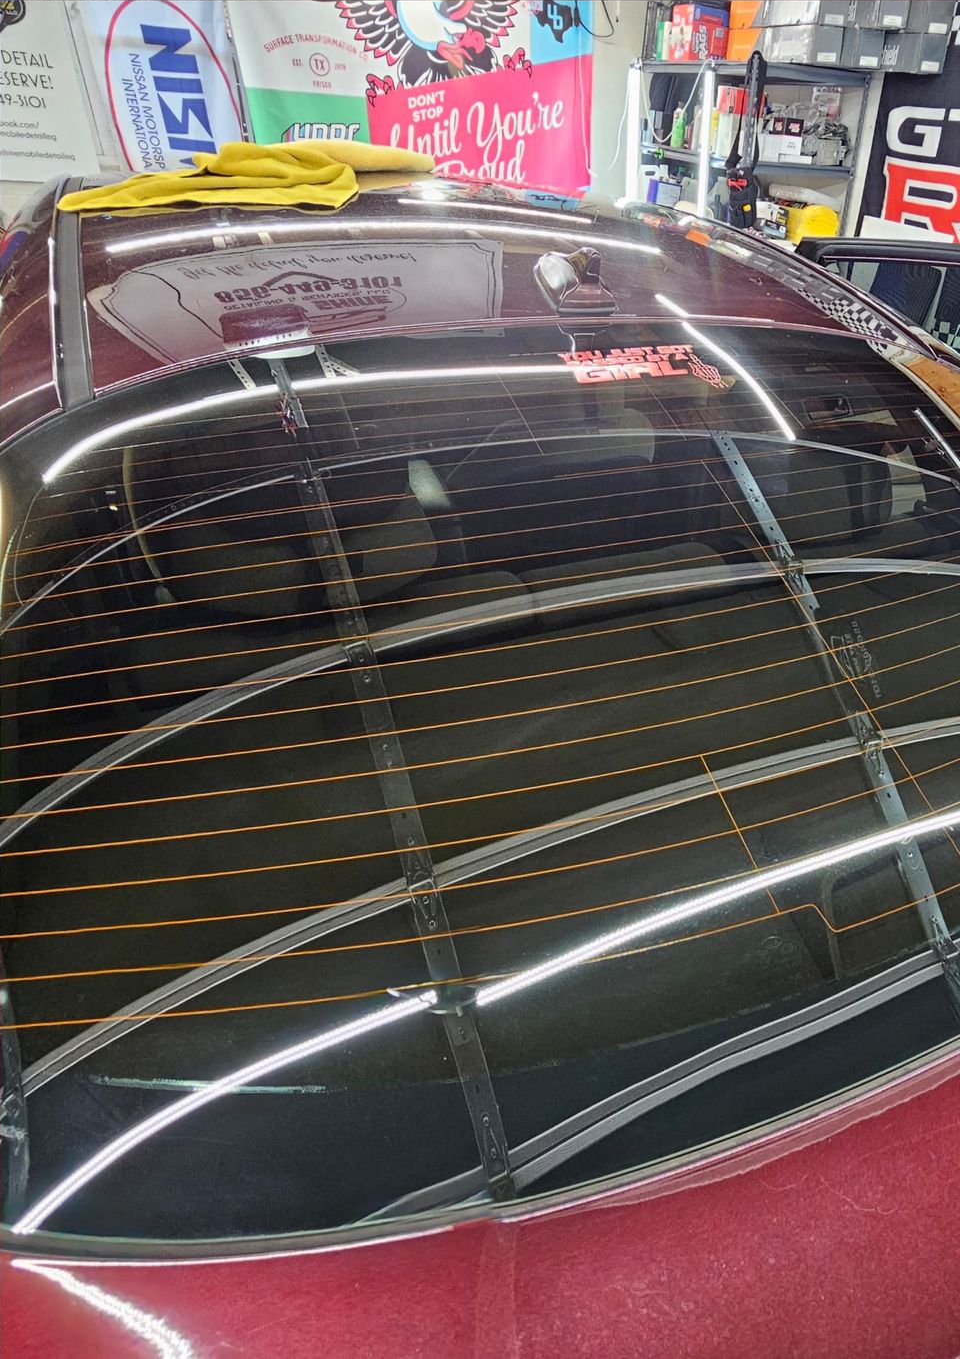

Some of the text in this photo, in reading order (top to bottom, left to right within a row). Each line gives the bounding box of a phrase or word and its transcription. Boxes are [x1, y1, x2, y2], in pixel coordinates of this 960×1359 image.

[263, 34, 294, 53] SURFACE
[294, 33, 357, 54] TRANSFORMATION
[0, 53, 54, 69] DETAIL
[314, 58, 326, 71] TX
[407, 90, 445, 109] DON'T
[129, 53, 166, 169] NISSAN MOTORSP
[412, 105, 444, 122] STOP
[121, 78, 153, 169] INTERNATIONA
[390, 91, 566, 165] Until You're
[886, 105, 960, 158] G
[557, 344, 694, 362] YOU JUST GOT
[573, 361, 689, 384] GIRL
